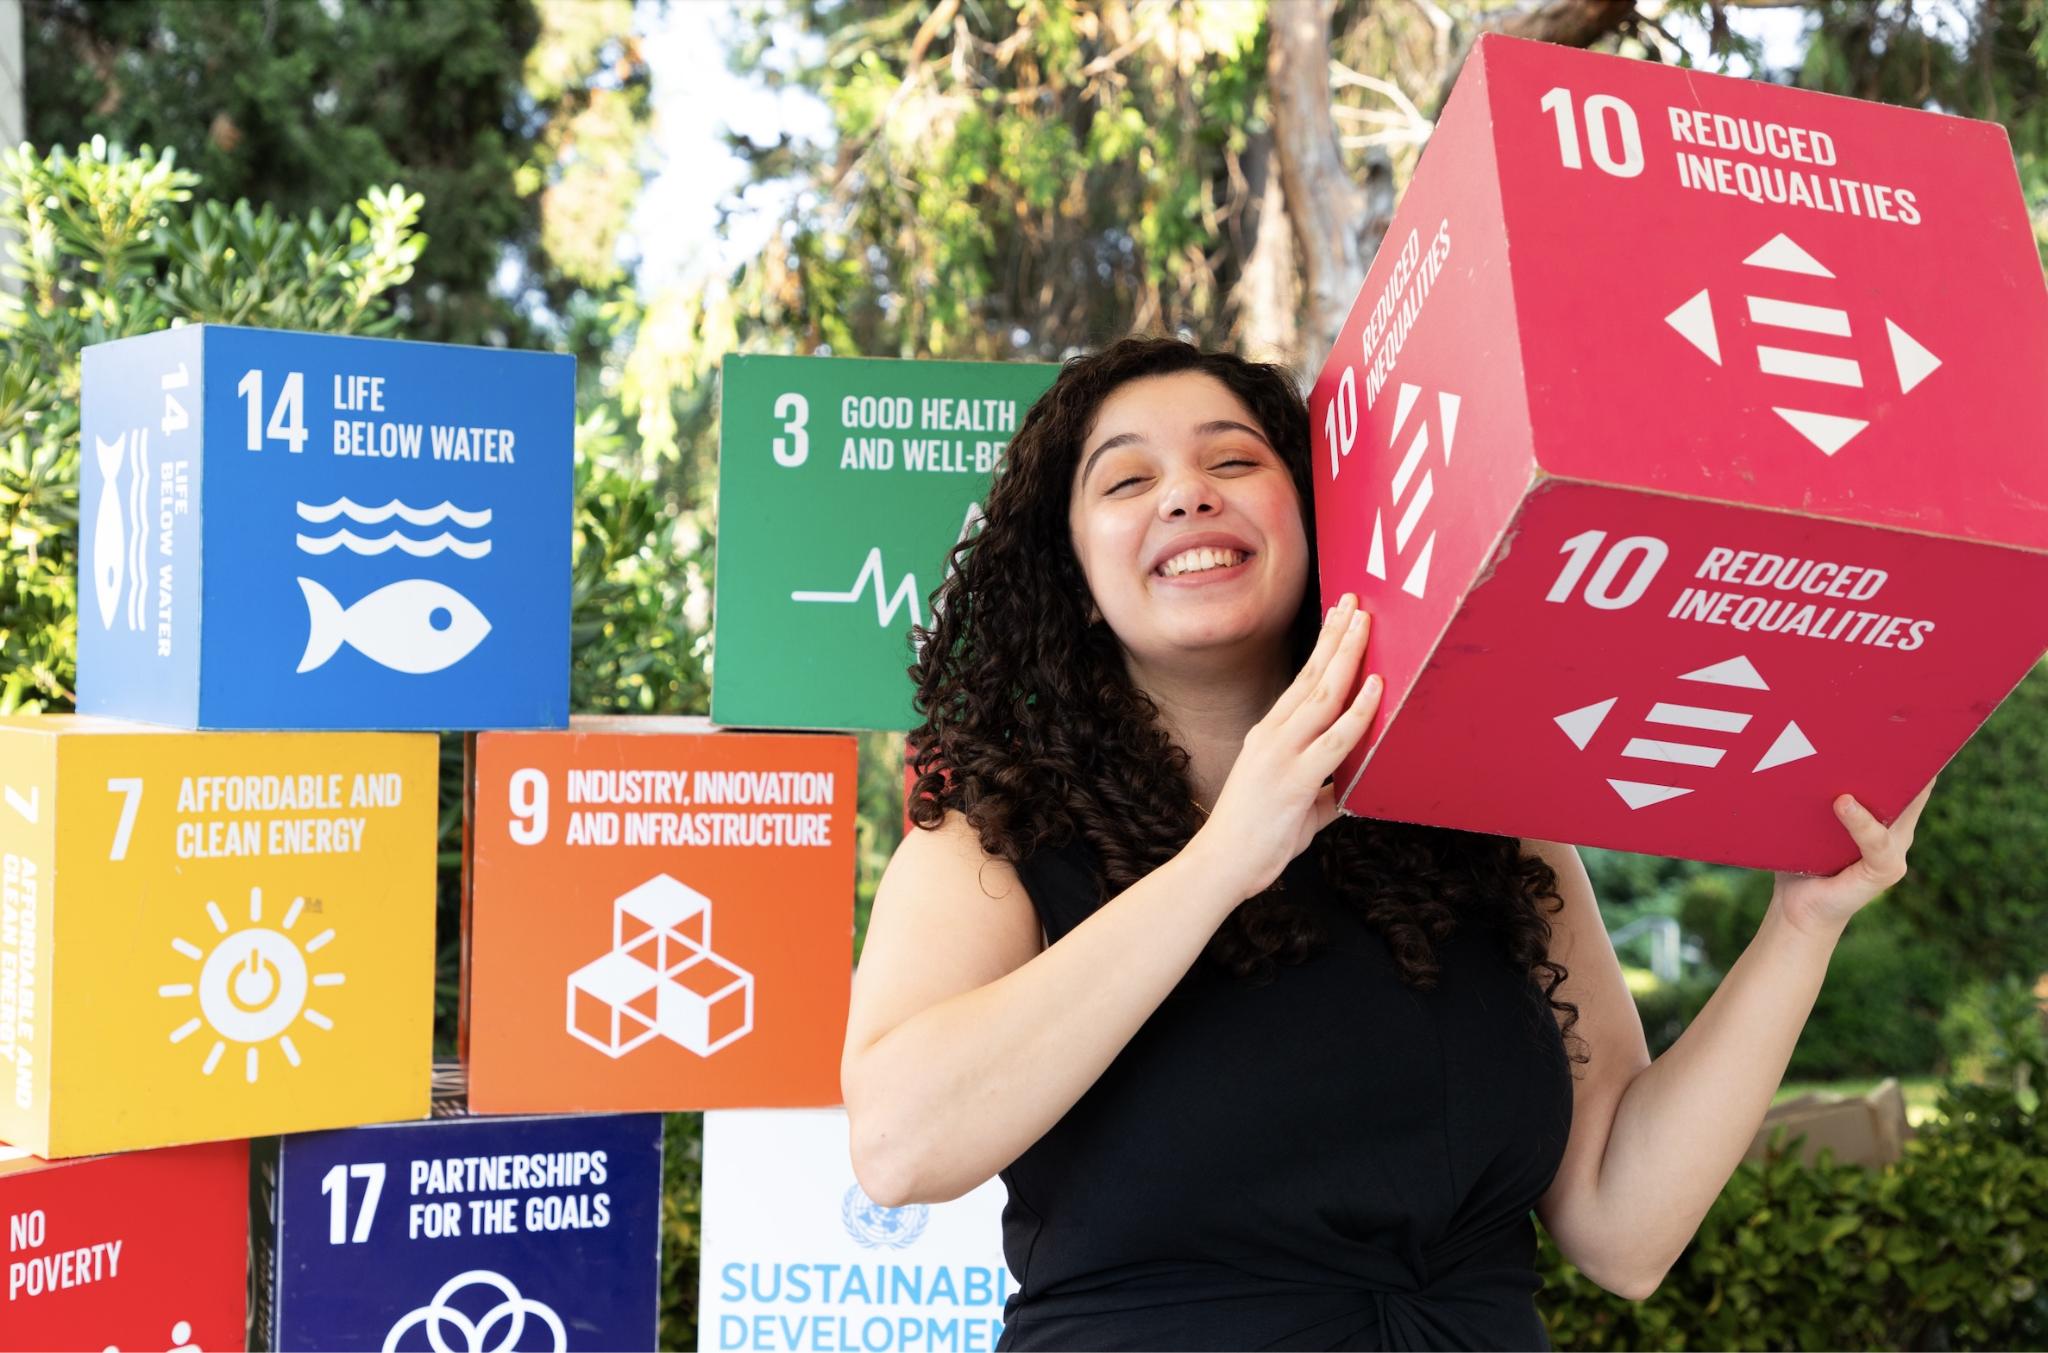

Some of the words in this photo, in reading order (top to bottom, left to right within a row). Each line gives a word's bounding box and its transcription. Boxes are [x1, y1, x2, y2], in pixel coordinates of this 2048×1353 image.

[1540, 87, 1645, 178] 10
[1667, 106, 1837, 169] REDUCED
[1676, 149, 1921, 226] INEQUALITIES
[1361, 227, 1420, 366] REDUCED
[1365, 217, 1452, 412] INEQUALITIES
[160, 361, 190, 437] 14
[237, 369, 309, 453] 14
[334, 374, 385, 412] LIFE
[841, 395, 914, 429] GOOD
[921, 398, 1016, 433] HEALTH
[1324, 364, 1358, 481] 10
[333, 419, 423, 459] BELOW
[430, 425, 515, 464] WATER
[772, 392, 809, 468] 3
[840, 437, 894, 470] AND
[902, 438, 1008, 474] WELL-BE
[159, 461, 175, 556] BELOW
[174, 460, 189, 515] LIFE
[1545, 529, 1669, 610] 10
[1693, 546, 1889, 603] REDUCED
[158, 564, 173, 657] WATER
[1667, 585, 1936, 651] INEQUALITIES
[107, 777, 144, 861] 7
[176, 773, 343, 813] AFFORDABLE
[349, 773, 402, 808] AND
[508, 767, 549, 846] 9
[567, 769, 691, 806] INDUSTRY,
[693, 771, 834, 805] INNOVATION
[176, 821, 261, 859] CLEAN
[268, 817, 366, 855] ENERGY
[566, 811, 620, 846] AND
[624, 812, 832, 847] INFRASTRUCTURE
[321, 1162, 386, 1245] 17
[410, 1150, 609, 1196] PARTNERSHIPS
[10, 1209, 46, 1252] NO
[409, 1202, 462, 1240] FOR
[468, 1198, 519, 1236] THE
[525, 1192, 611, 1232] GOALS
[9, 1238, 122, 1301] POVERTY
[720, 1261, 1007, 1307] SUSTAINABL
[718, 1314, 1004, 1352] DEVELOPME
